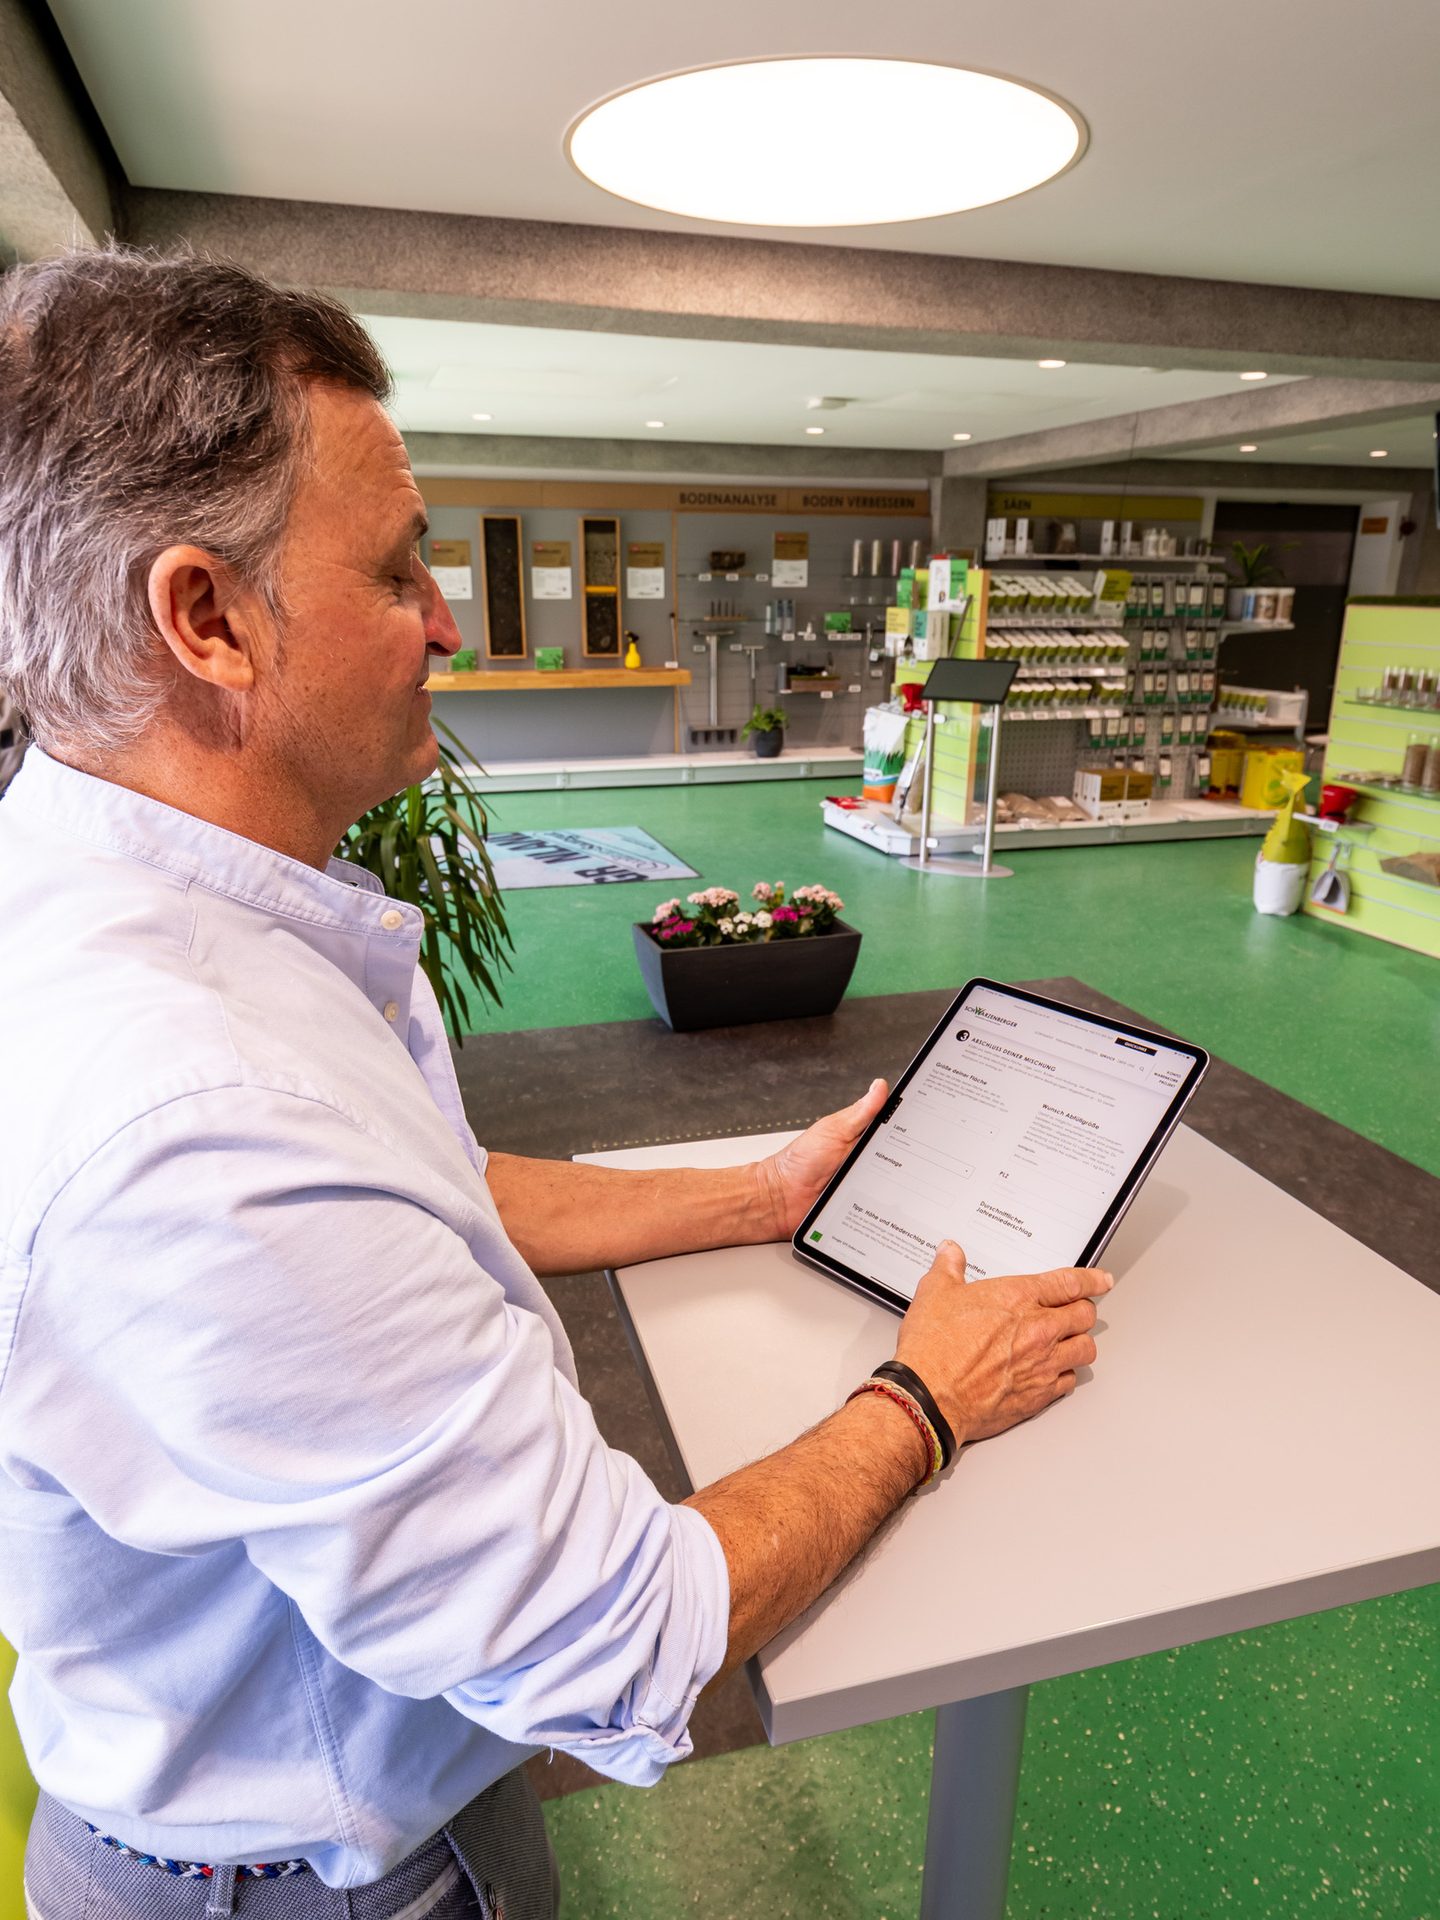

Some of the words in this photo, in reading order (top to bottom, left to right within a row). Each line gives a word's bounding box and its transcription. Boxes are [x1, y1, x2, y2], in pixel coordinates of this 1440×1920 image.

[679, 492, 777, 507] BODENANALYSE
[802, 494, 843, 508] BODEN
[847, 496, 915, 509] VERBESSERN
[964, 1005, 1018, 1028] SCHWARZENBERGER
[971, 1037, 1002, 1052] ABSCHLUSS
[1002, 1048, 1023, 1060] DEINER
[1024, 1056, 1056, 1072] MISCHUNG
[952, 1067, 969, 1078] deiner
[1042, 1103, 1065, 1116] Wunsch
[893, 1123, 907, 1133] Land
[874, 1151, 903, 1168] Höhenlage
[864, 1210, 879, 1220] Höhe
[879, 1217, 891, 1226] und
[889, 1223, 926, 1245] Niederschlag
[976, 1206, 1033, 1238] Jahresniederschlag
